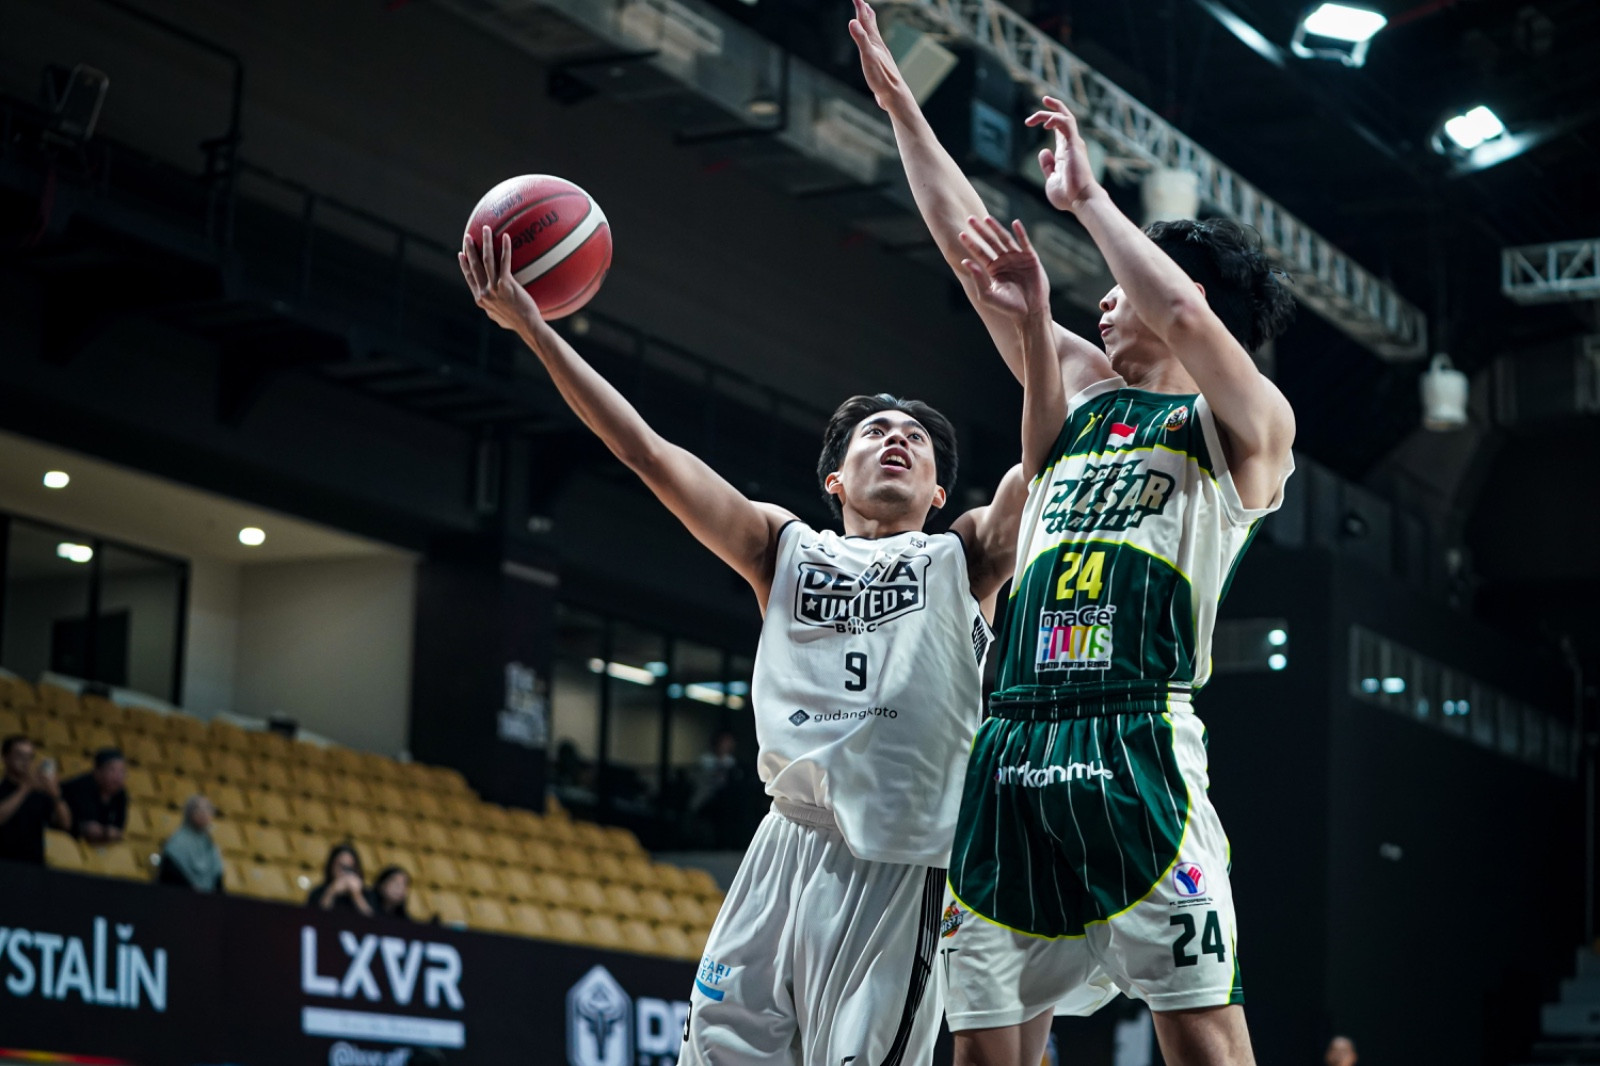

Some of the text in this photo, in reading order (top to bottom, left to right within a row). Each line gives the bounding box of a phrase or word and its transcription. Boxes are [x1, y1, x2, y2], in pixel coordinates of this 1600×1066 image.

[512, 210, 559, 249] molte
[1056, 551, 1105, 600] 24
[845, 652, 867, 691] 9
[1170, 911, 1226, 968] 24
[302, 926, 465, 1010] LXVR
[698, 968, 721, 985] EAT
[700, 956, 732, 977] CARI
